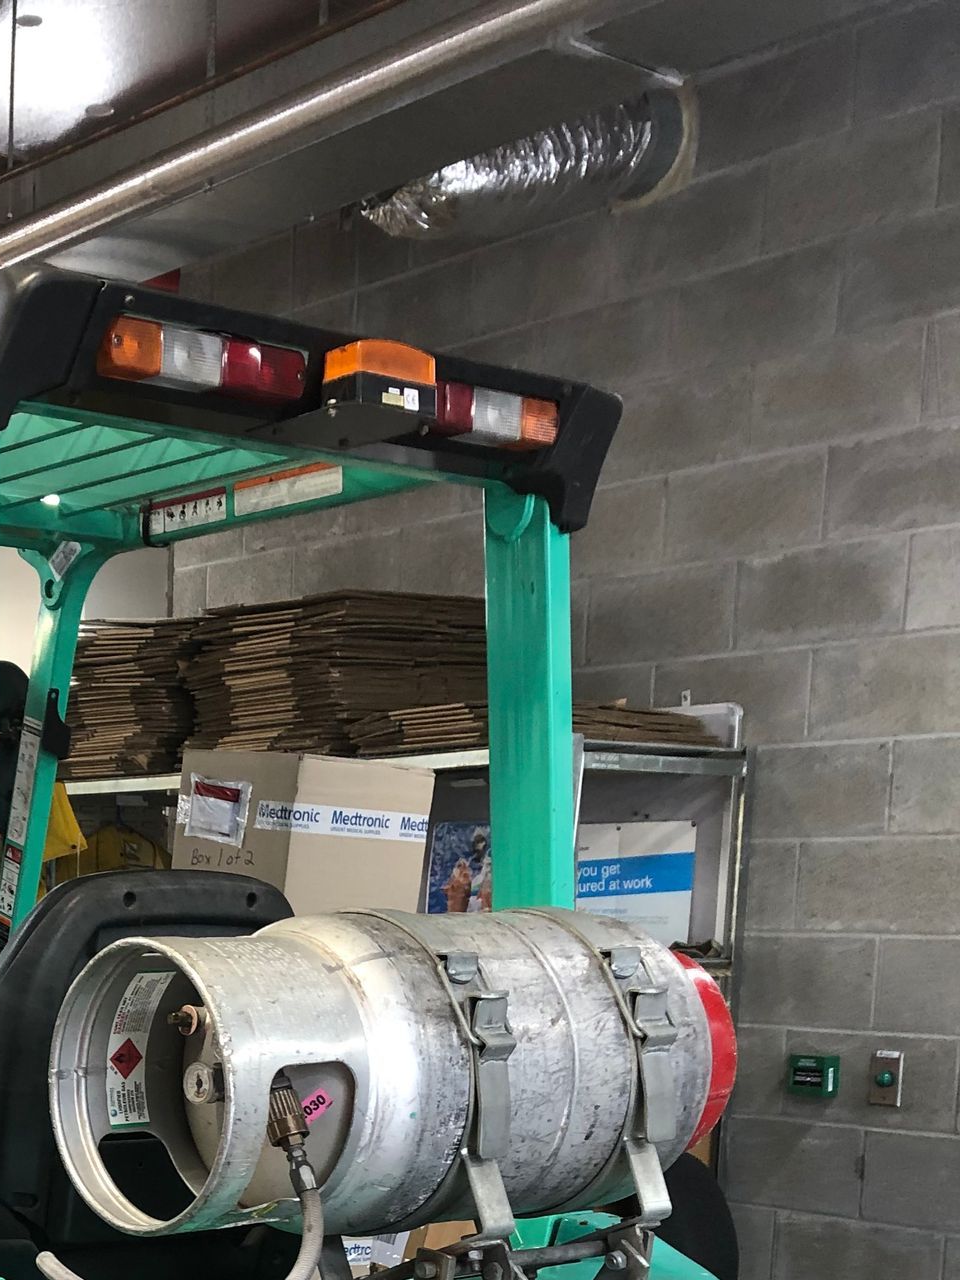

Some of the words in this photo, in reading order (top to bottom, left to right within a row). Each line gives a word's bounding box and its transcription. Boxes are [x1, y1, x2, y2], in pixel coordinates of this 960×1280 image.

[259, 804, 320, 823] Medtronic
[331, 810, 391, 829] Medtronic
[191, 848, 211, 865] Box
[226, 848, 241, 865] of
[244, 850, 255, 866] 2
[601, 863, 621, 878] get
[609, 879, 620, 890] at
[623, 875, 654, 889] work
[303, 1095, 326, 1118] 030
